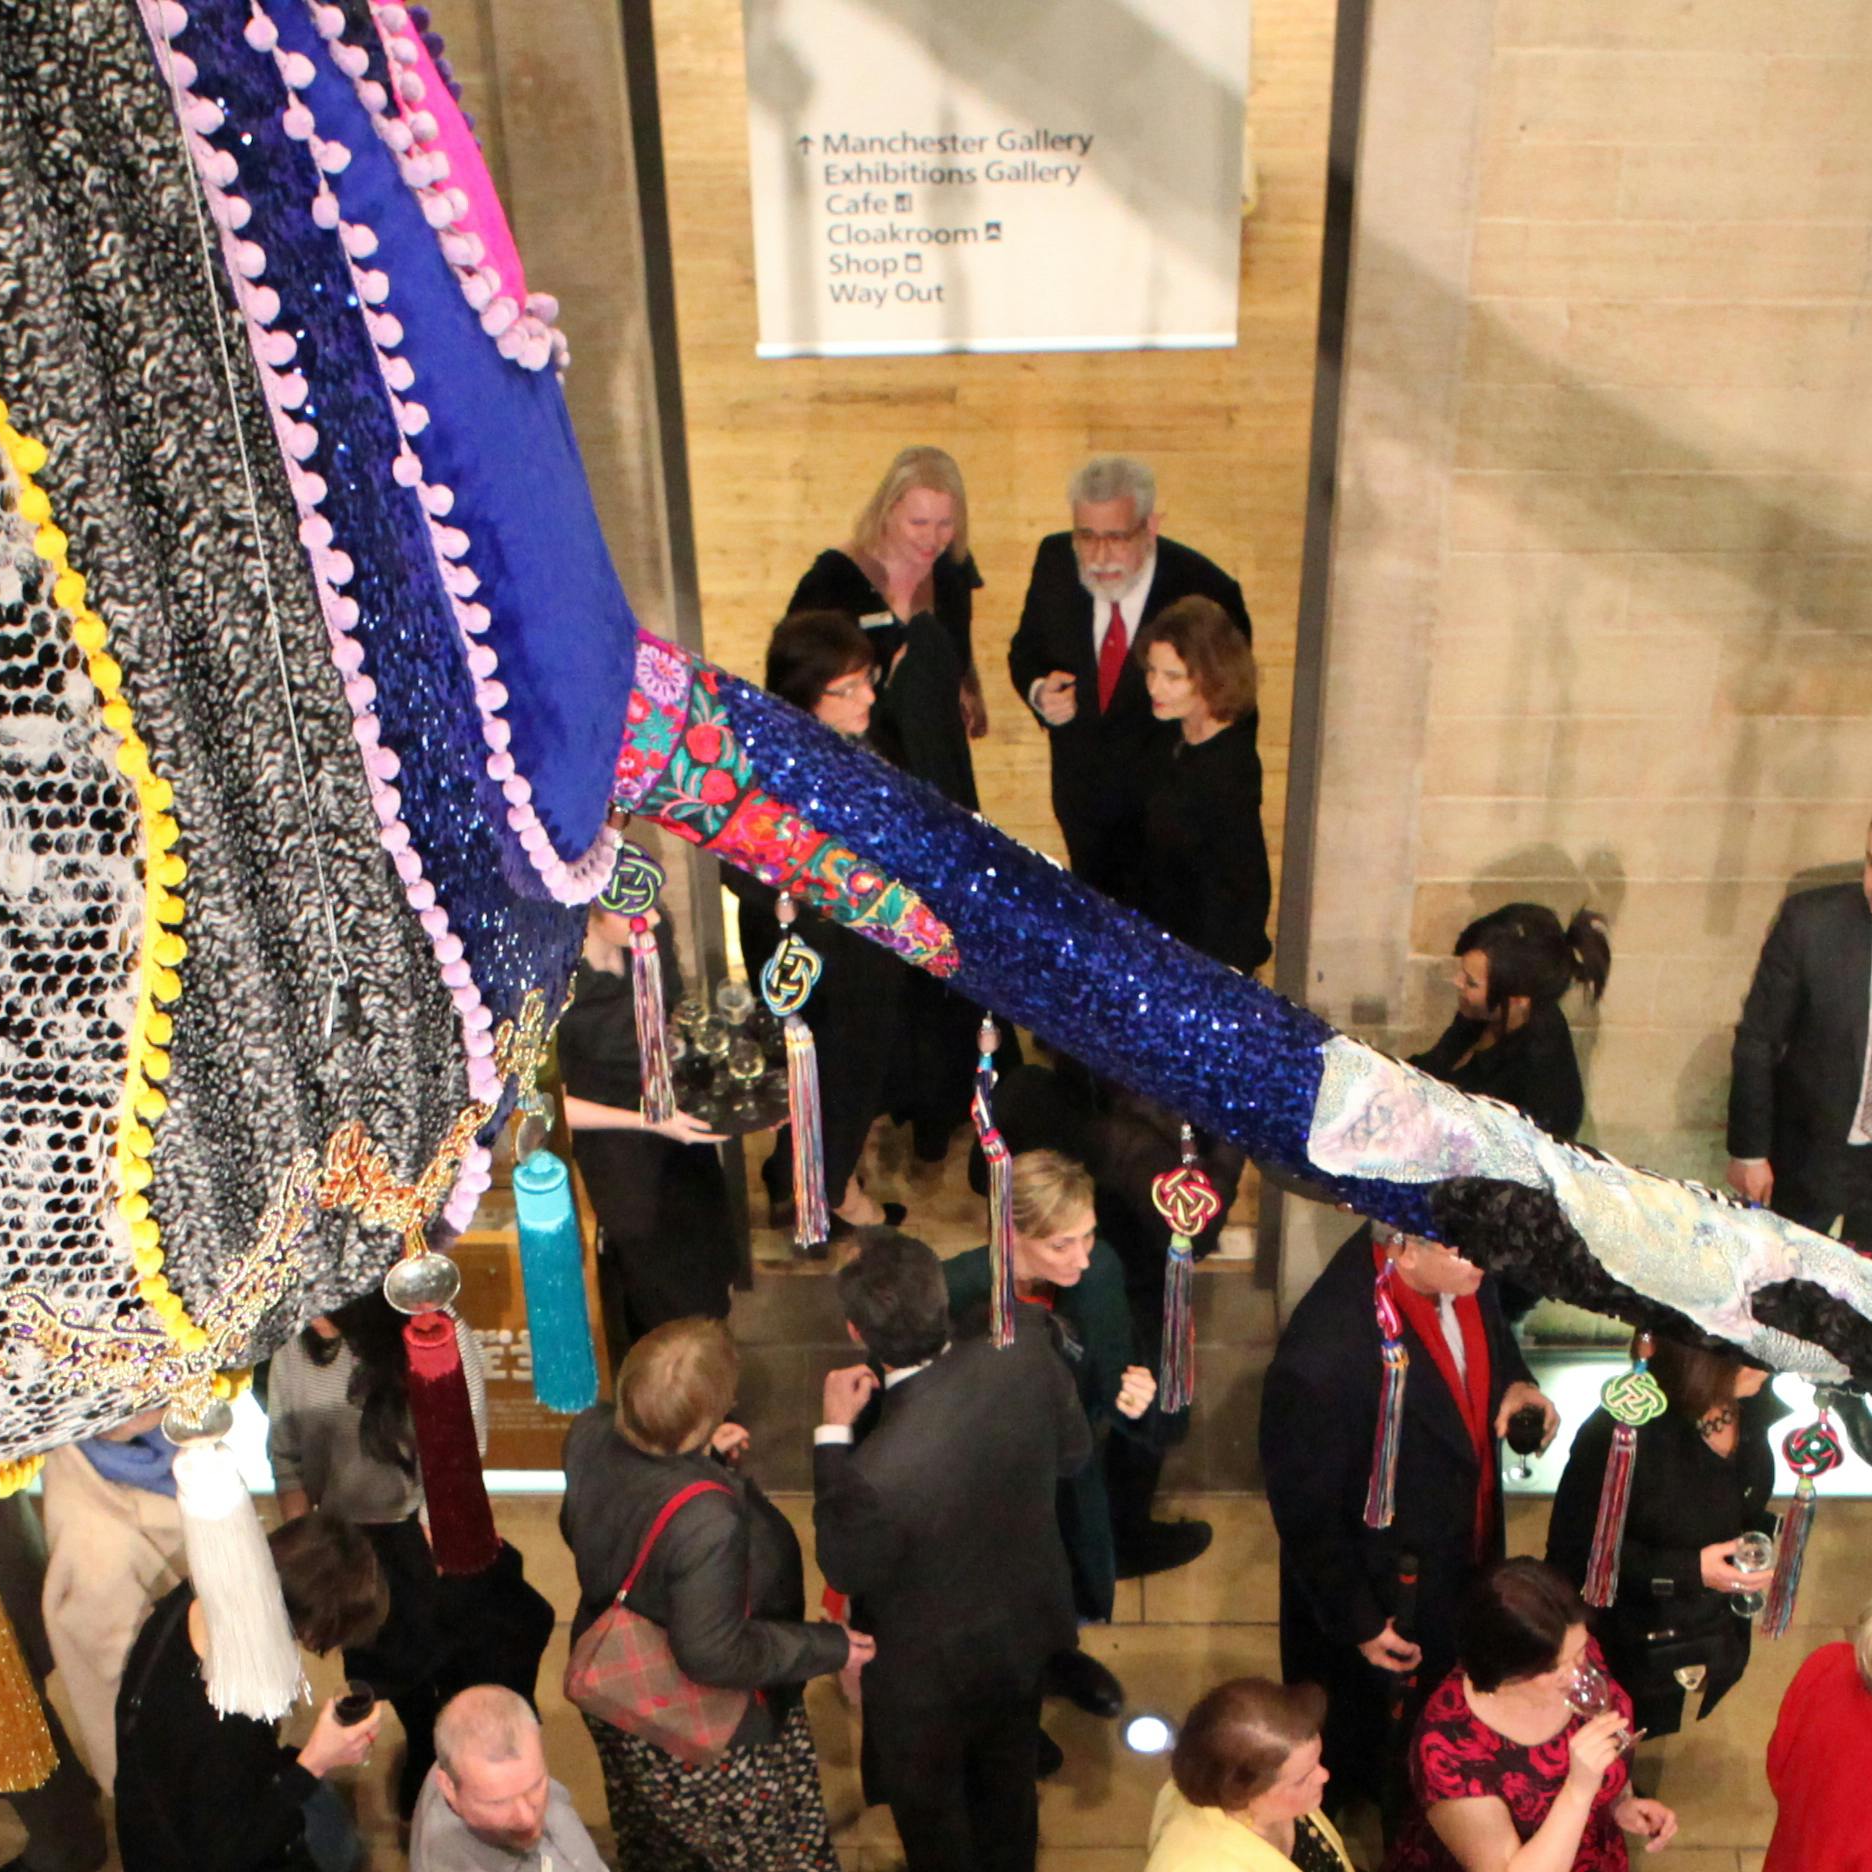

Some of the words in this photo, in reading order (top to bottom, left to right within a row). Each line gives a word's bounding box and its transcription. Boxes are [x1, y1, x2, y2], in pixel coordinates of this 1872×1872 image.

[823, 130, 989, 154] Manchester
[996, 129, 1094, 157] Gallery
[824, 160, 977, 186] Exhibitions
[984, 159, 1081, 188] Gallery
[826, 191, 888, 215] Cafe
[827, 222, 978, 245] Cloakroom
[829, 253, 899, 279] Shop
[829, 283, 888, 310] Way
[895, 281, 945, 303] Out
